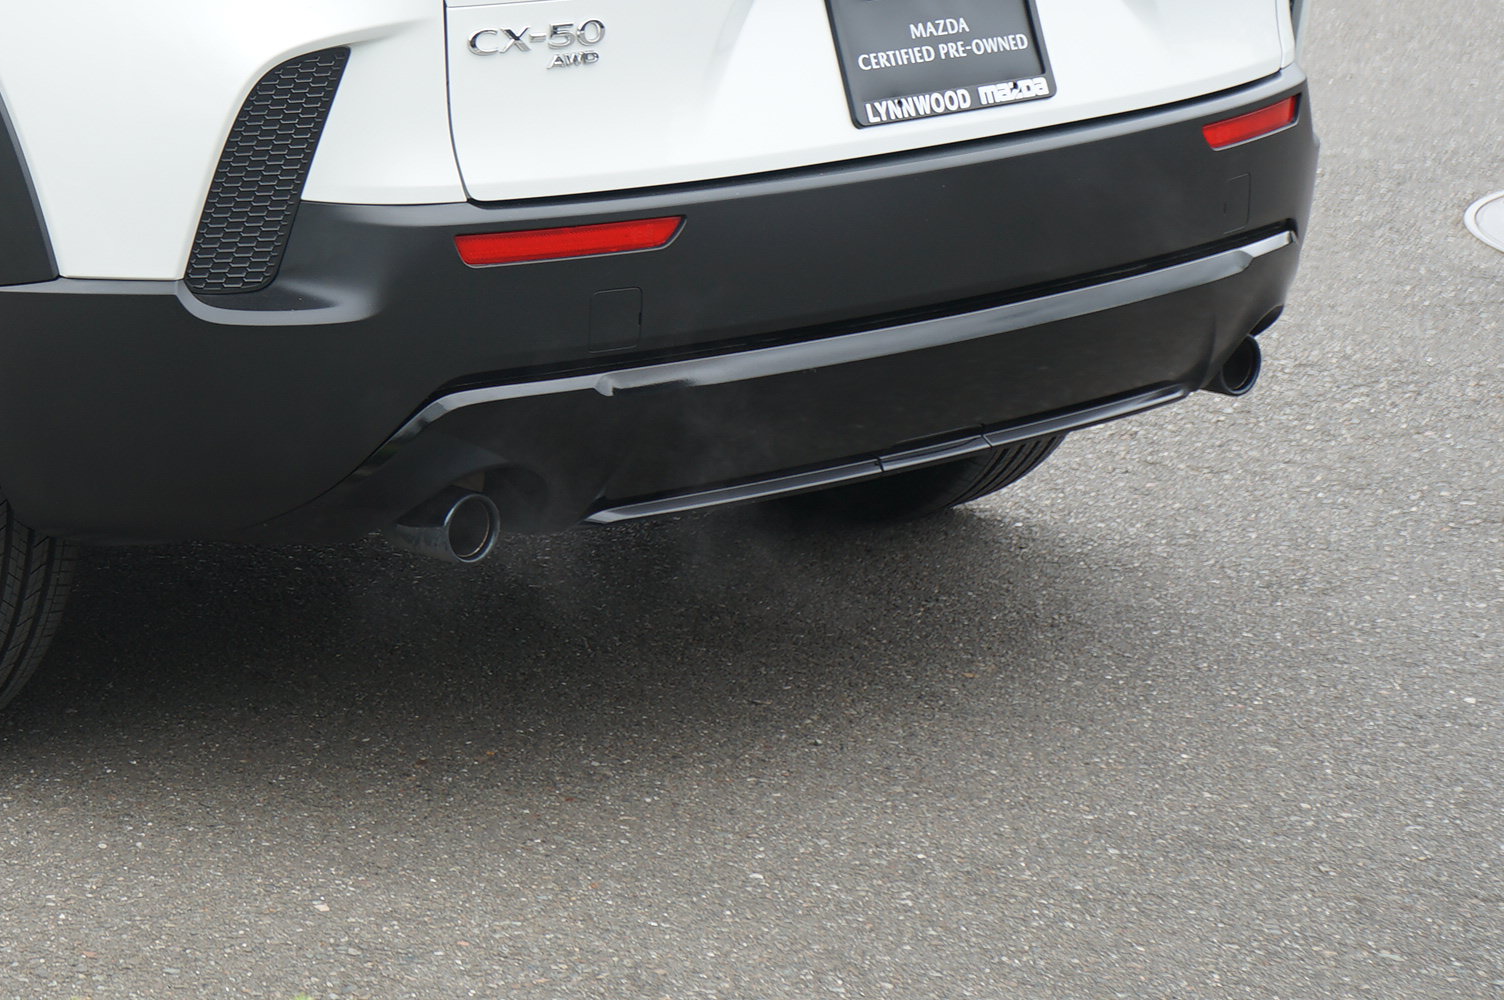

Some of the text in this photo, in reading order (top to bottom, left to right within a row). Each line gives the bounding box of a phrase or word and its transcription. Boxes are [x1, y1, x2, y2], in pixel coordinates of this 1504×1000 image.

[467, 18, 606, 56] CX-50
[909, 17, 970, 39] MAZDA
[546, 50, 600, 69] AWD
[857, 33, 1029, 71] CERTIFIED PRE-OWNED
[865, 88, 972, 123] LYNNWOOD
